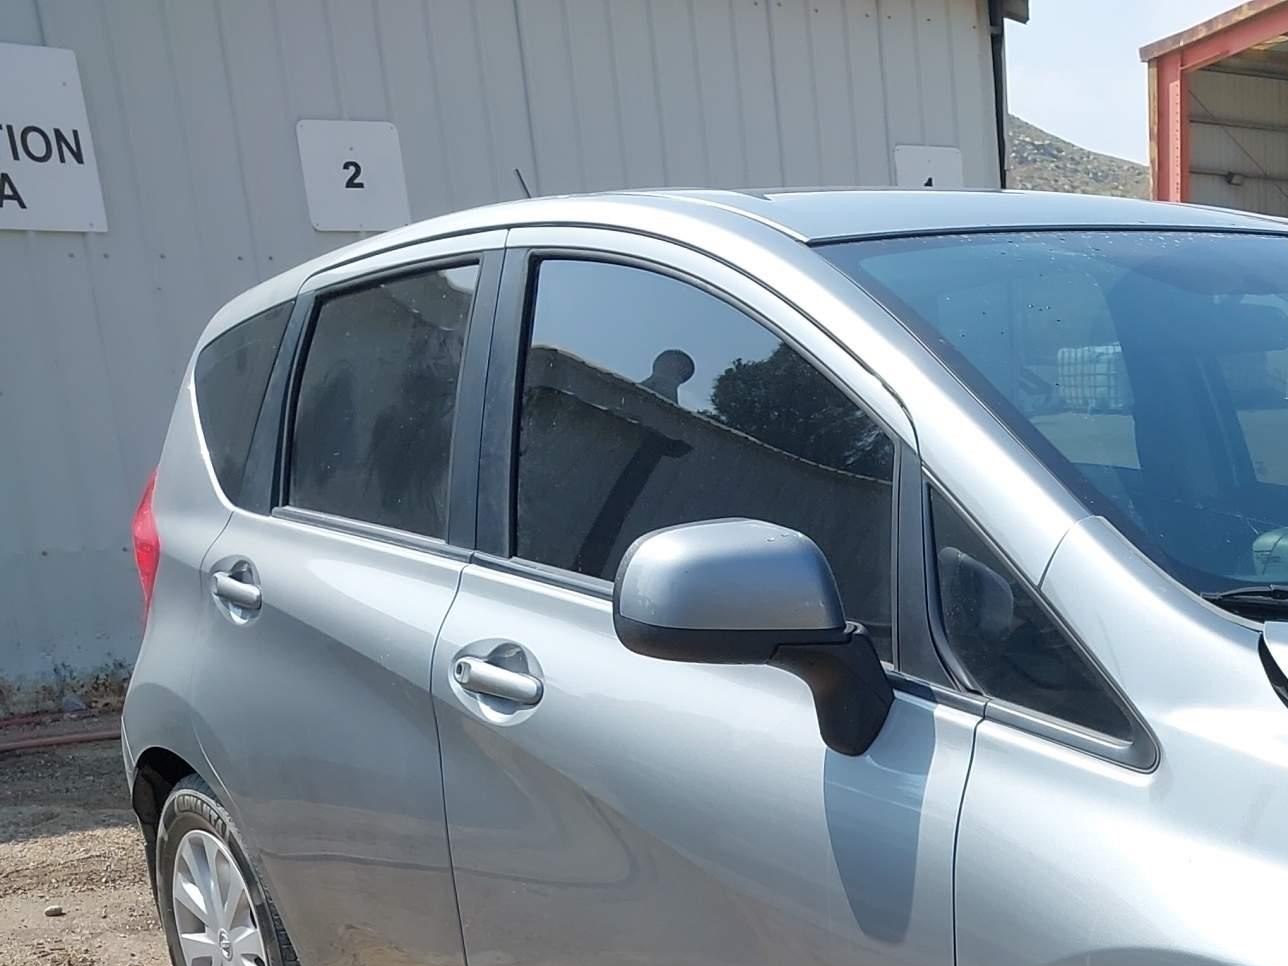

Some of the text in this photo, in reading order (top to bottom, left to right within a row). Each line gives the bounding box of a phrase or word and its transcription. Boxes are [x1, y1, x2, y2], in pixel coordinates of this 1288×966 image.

[0, 124, 84, 165] ION
[0, 172, 28, 209] A
[342, 161, 365, 189] 2
